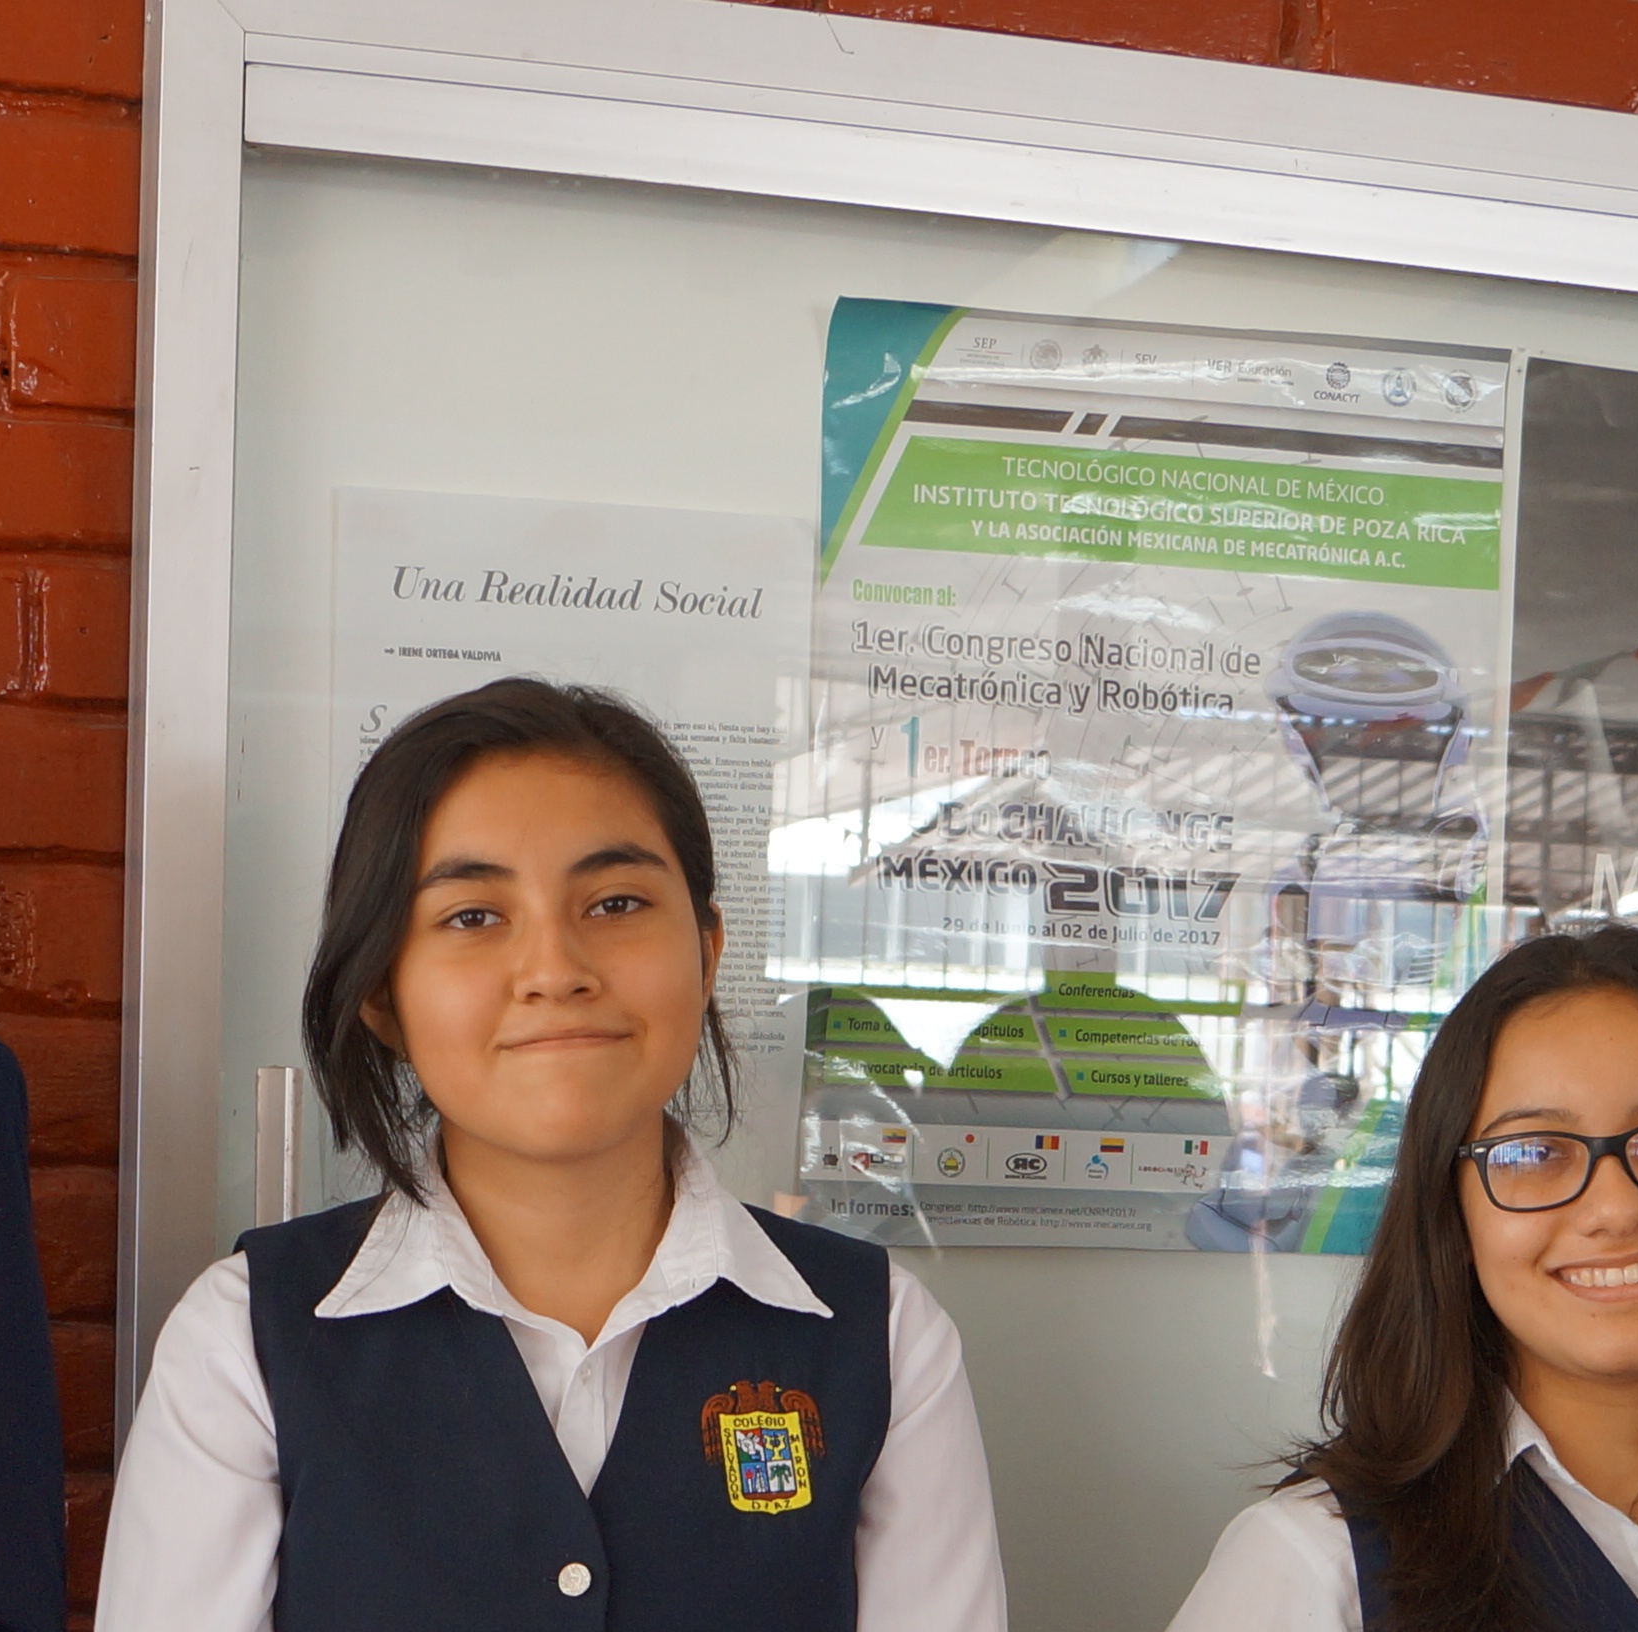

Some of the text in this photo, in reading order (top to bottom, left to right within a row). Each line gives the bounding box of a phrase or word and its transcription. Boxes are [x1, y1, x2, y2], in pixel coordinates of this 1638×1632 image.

[973, 337, 1359, 404] SEP CONACYT
[1003, 455, 1384, 506] TECNOLÓGICO NACIONAL DE MÉXICO
[913, 485, 1037, 512] INSTITUTO
[1211, 506, 1313, 532] SUPERIOR
[1320, 514, 1346, 535] DE
[1353, 515, 1409, 540] POZA
[1417, 521, 1466, 545] RICA
[971, 519, 1405, 569] Y LA ASOCIACIÓN MEXICANA DE MECATRÓNICA A.C.
[393, 566, 764, 619] Una Realidad Social
[852, 579, 956, 607] Convocan al:
[399, 647, 501, 662] IRENE ORTEGA VALDIVIA
[852, 620, 1261, 675] 1er. Congreso Nacional de
[872, 665, 1234, 716] Mecatrónica y Robótica
[1042, 858, 1240, 922] 2017
[1041, 922, 1057, 936] al
[1062, 924, 1084, 940] 02
[1088, 924, 1108, 940] de
[1154, 927, 1173, 943] de
[1178, 930, 1221, 946] 2017
[1058, 984, 1135, 998] Conferencias
[1076, 1029, 1159, 1046] Competencias
[1091, 1070, 1188, 1087] Cursos y talleres
